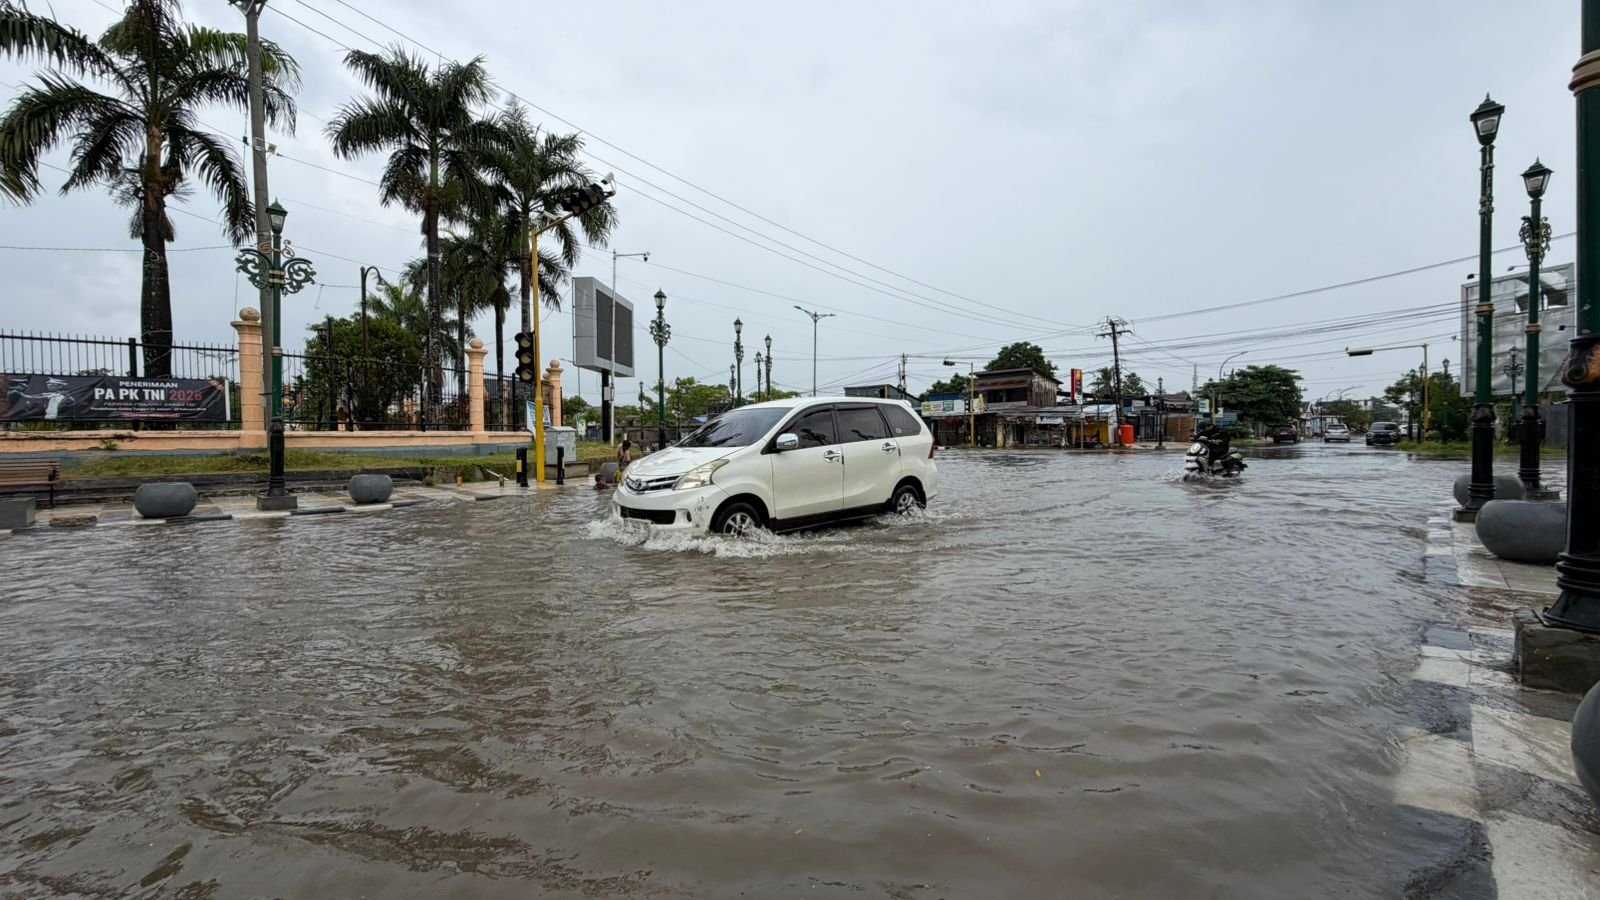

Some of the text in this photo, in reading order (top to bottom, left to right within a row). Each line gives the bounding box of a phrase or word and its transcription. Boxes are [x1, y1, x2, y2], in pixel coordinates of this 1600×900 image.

[119, 380, 178, 388] PENERIMAAN
[94, 388, 204, 401] PA PK TNI 2026
